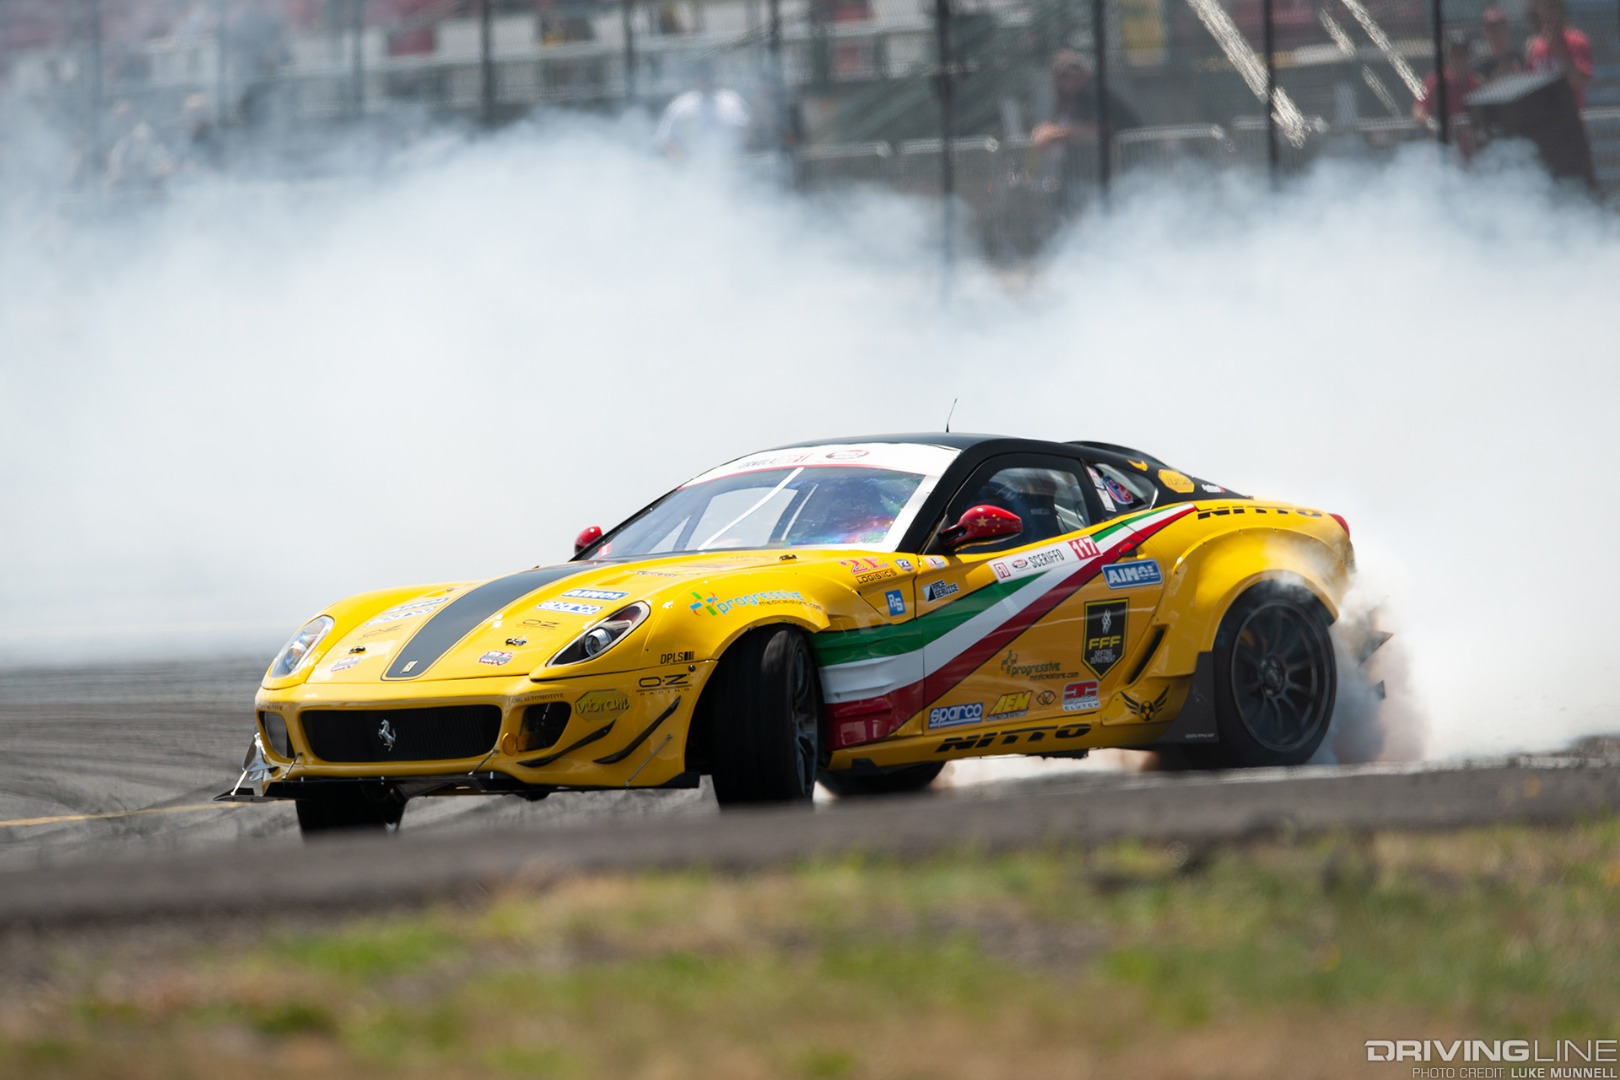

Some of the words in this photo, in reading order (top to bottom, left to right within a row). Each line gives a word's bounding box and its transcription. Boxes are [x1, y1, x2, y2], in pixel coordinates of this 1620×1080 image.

[1197, 505, 1323, 520] NITTO
[1073, 539, 1097, 559] 117
[1028, 549, 1065, 568] SCERIFFO
[856, 569, 897, 585] LOGISTICS
[934, 584, 959, 599] SERVICE
[716, 589, 805, 616] progressive
[888, 594, 903, 612] RS
[1088, 635, 1121, 650] FFF
[660, 651, 683, 664] DPLS
[1011, 662, 1061, 677] progressive
[989, 691, 1031, 716] AEM
[1064, 702, 1099, 711] CLUTCH
[930, 704, 982, 724] sparco
[935, 723, 1092, 753] NITTO
